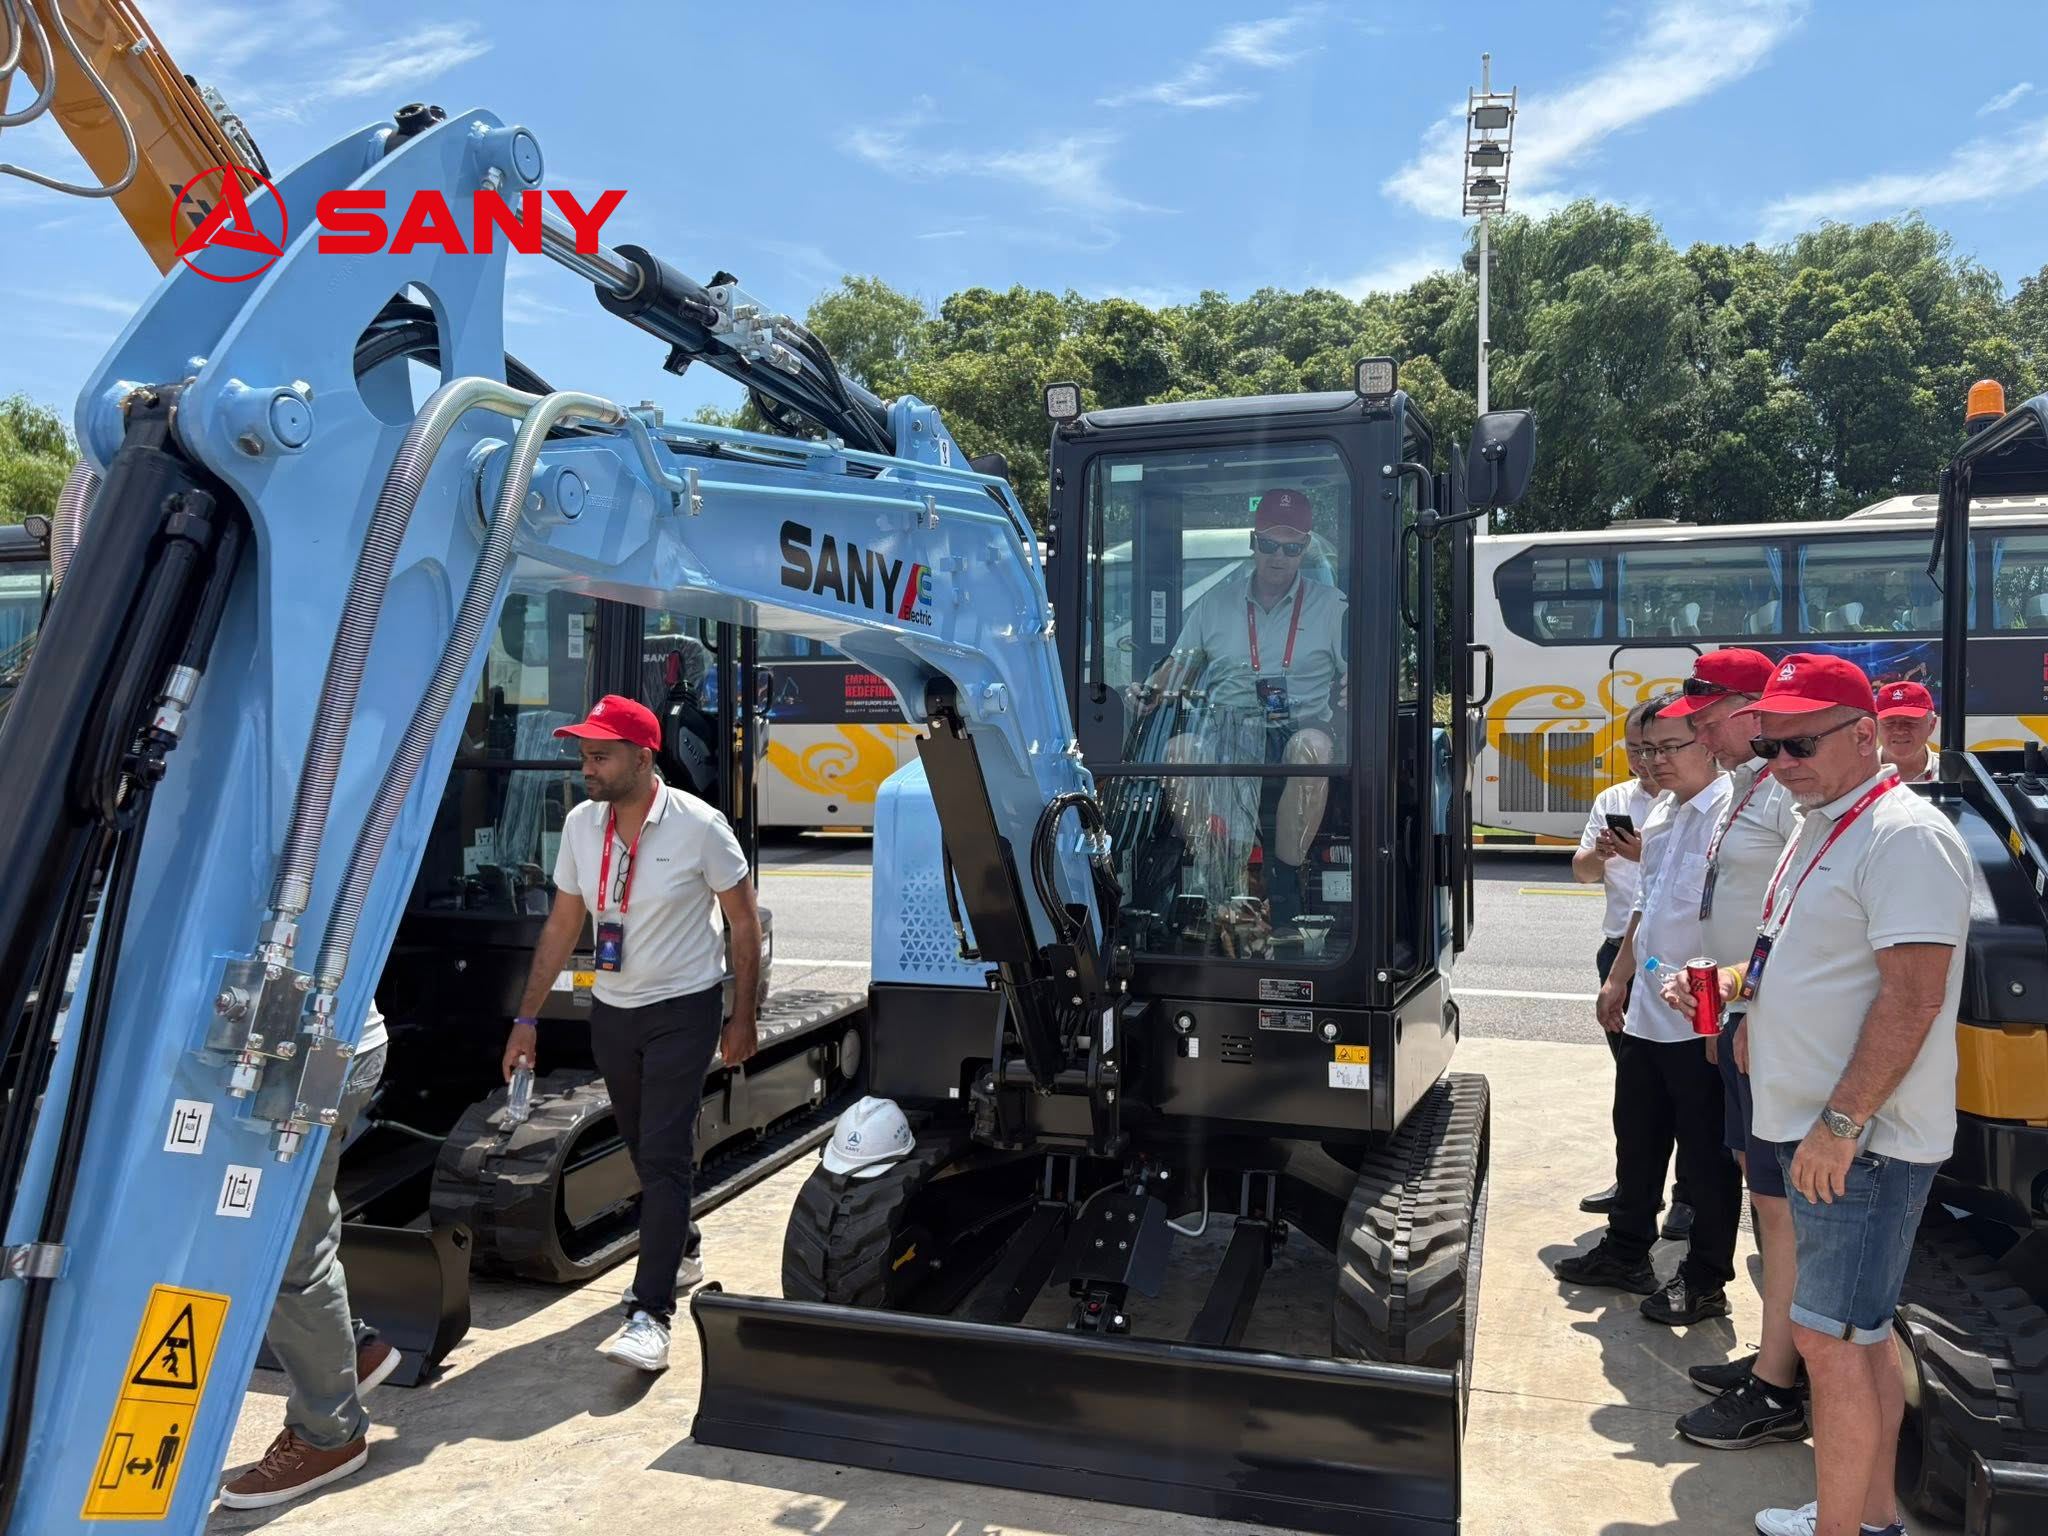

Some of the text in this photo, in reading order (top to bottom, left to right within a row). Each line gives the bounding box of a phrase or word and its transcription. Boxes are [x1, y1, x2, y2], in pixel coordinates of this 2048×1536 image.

[780, 520, 903, 614] SANY
[903, 604, 932, 626] Electric
[643, 653, 669, 663] SAN
